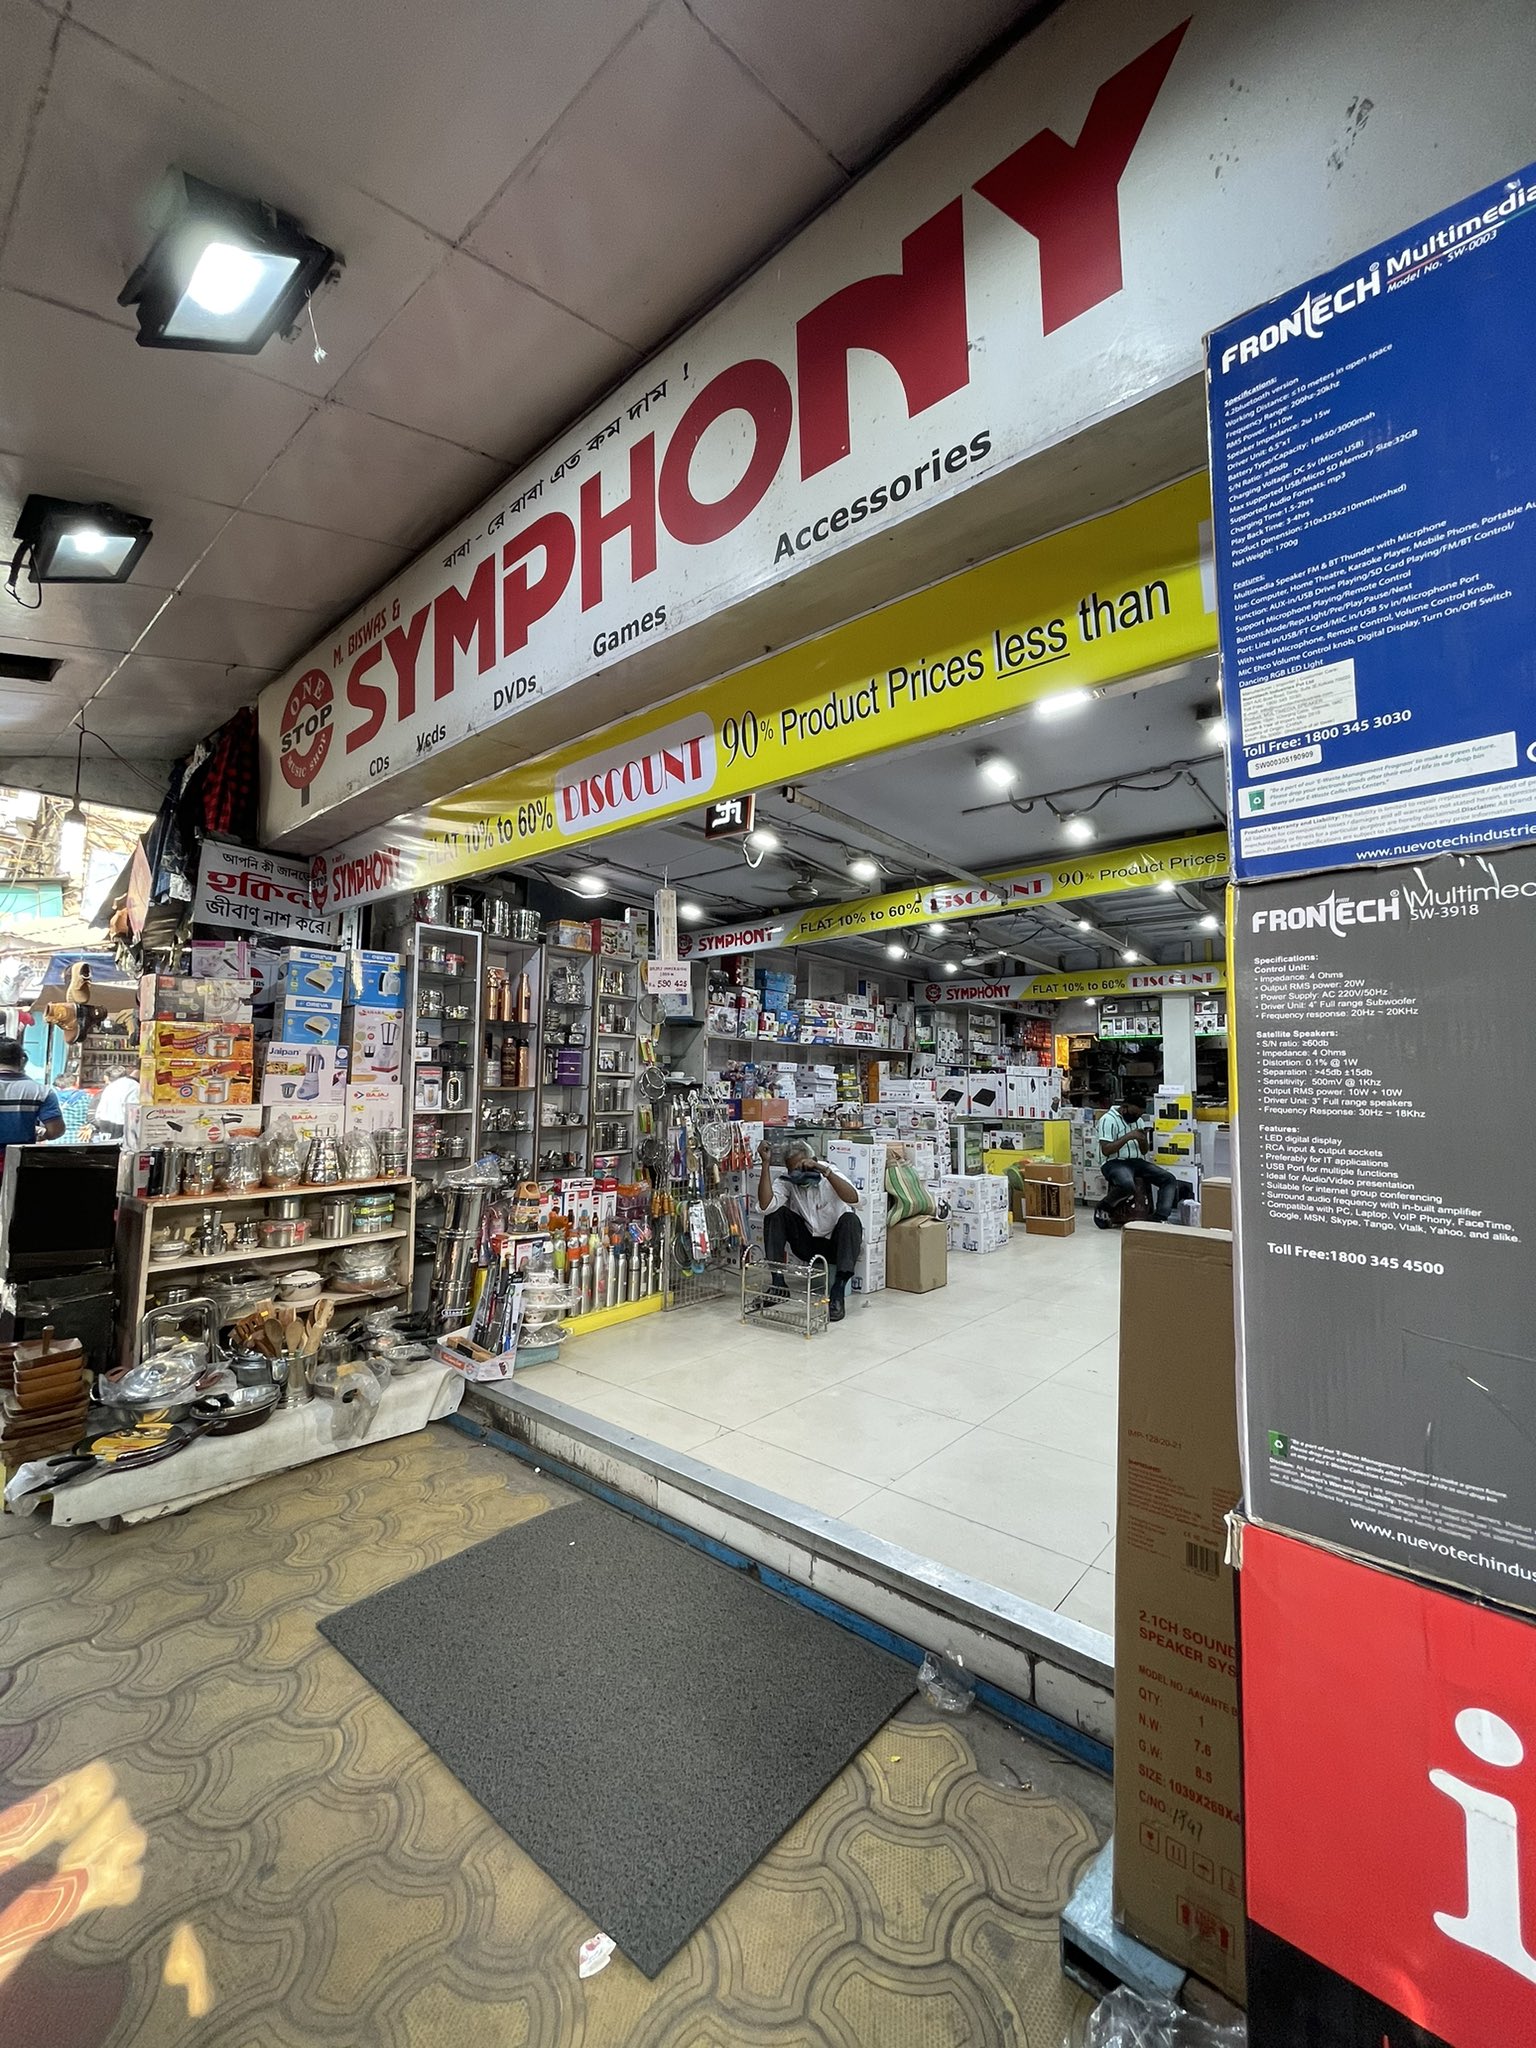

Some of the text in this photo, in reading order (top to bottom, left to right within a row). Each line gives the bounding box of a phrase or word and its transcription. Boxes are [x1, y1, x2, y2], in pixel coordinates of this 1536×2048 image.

[1386, 229, 1498, 294] Model No. SW-0003
[1222, 266, 1381, 374] FRONTECH
[346, 14, 1193, 755] SYMPHONY
[1224, 377, 1278, 408] Specifications:
[1225, 412, 1255, 428] Working
[1256, 394, 1290, 414] Distance:
[1308, 372, 1334, 388] meters
[1336, 364, 1344, 374] in
[1346, 357, 1367, 372] open
[1368, 344, 1393, 360] space
[442, 539, 470, 568] বাবা
[488, 511, 506, 536] রে
[510, 480, 544, 513] বাবা
[550, 450, 582, 484] এত
[587, 417, 622, 451] কম
[627, 380, 668, 420] দাম
[772, 430, 992, 564] Accessories
[1232, 543, 1260, 558] Product
[1260, 526, 1303, 546] Dimension:
[1233, 574, 1266, 591] Features:
[1234, 582, 1274, 600] Multimedia
[1276, 570, 1306, 588] Speaker
[1307, 564, 1320, 575] FM
[1321, 562, 1328, 570] &
[1329, 558, 1339, 568] BT
[1340, 546, 1375, 563] Thunder
[1376, 538, 1396, 550] with
[334, 598, 400, 668] M. BISWAS &
[592, 604, 667, 658] Games
[1239, 658, 1324, 688] Dancing RGB LED Light
[290, 676, 326, 716] ONE
[493, 674, 537, 712] DVDs
[281, 704, 332, 753] STOP
[466, 818, 494, 853] 10%
[498, 815, 513, 844] to
[517, 797, 552, 838] 60%
[562, 736, 706, 823] DISCOUNT
[722, 710, 774, 768] 90%
[780, 677, 879, 746] Product
[887, 645, 984, 708] Prices
[995, 617, 1068, 673] less
[1078, 580, 1170, 642] than
[1242, 709, 1412, 758] Toll Free: 1800 345 3030
[287, 733, 327, 778] MUSIC SHOP
[370, 756, 390, 776] CDs
[222, 852, 258, 870] আপনি
[262, 860, 274, 874] কী
[800, 918, 833, 934] FLAT
[838, 911, 866, 927] 10%
[870, 909, 884, 920] to
[889, 902, 920, 918] 60%
[1058, 868, 1094, 887] 90%
[1100, 861, 1164, 880] Product
[1170, 852, 1226, 870] Prices
[206, 895, 260, 927] জীবাণু
[264, 910, 292, 928] নাশ
[1252, 891, 1400, 937] FRONTECH
[1410, 904, 1480, 920] SW-3918
[1254, 954, 1318, 966] Specifications:
[946, 985, 1010, 1000] SYMPHONY
[1032, 972, 1214, 994] FLAT 10% to 60% DISCOUNT
[1260, 979, 1365, 992] Output RMS power: 20W
[1256, 1030, 1338, 1039] Satellite Speakers:
[269, 1048, 300, 1056] Jaipan
[1259, 1125, 1300, 1134] Features:
[1266, 1163, 1398, 1179] USB Port for multiple functions
[1269, 1210, 1302, 1222] Google,
[1304, 1214, 1328, 1224] MSN,
[1330, 1216, 1361, 1228] Skype,
[1364, 1219, 1396, 1232] Tango,
[1430, 1226, 1466, 1238] Yahoo,
[1470, 1230, 1490, 1240] and
[1492, 1232, 1522, 1244] alike.
[1267, 1242, 1444, 1276] Toll Free:1800 345 4500
[1139, 1610, 1178, 1635] 2.1CH
[1139, 1627, 1203, 1663] SPEAKER
[1138, 1664, 1168, 1686] MODEL
[1138, 1764, 1166, 1788] SIZE:
